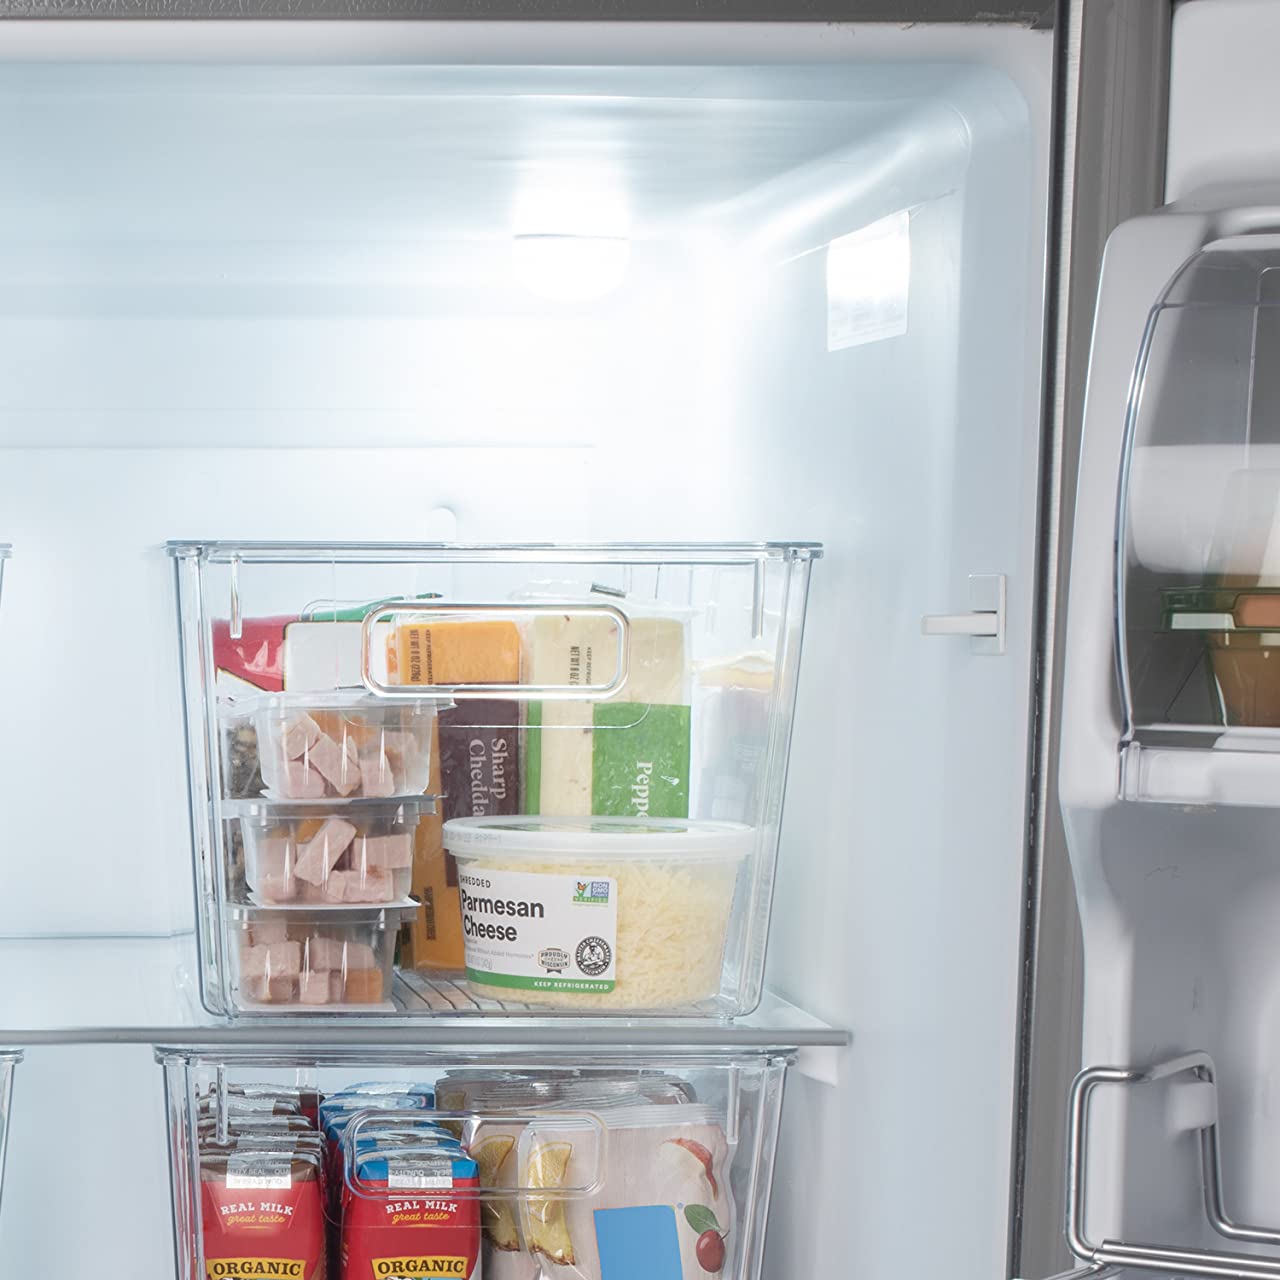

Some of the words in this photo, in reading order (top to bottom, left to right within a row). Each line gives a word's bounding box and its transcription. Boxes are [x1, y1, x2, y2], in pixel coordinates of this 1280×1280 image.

[570, 646, 580, 656] NET
[570, 657, 580, 666] WT
[570, 672, 580, 680] OZ
[489, 737, 509, 799] Sharp
[460, 889, 545, 919] Parmesan
[463, 915, 518, 941] Cheese
[541, 951, 568, 959] PROUDLY
[541, 960, 568, 968] WISCONSIN
[554, 982, 609, 990] REFRIGERATED
[221, 1202, 255, 1215] REAL
[260, 1202, 293, 1215] MILK
[385, 1201, 420, 1214] REAL
[425, 1201, 458, 1213] MILK
[227, 1215, 257, 1226] great
[259, 1215, 286, 1223] taste
[392, 1212, 421, 1224] great
[424, 1211, 449, 1220] taste
[213, 1262, 300, 1276] ORGANIC
[377, 1260, 464, 1274] ORGANIC
